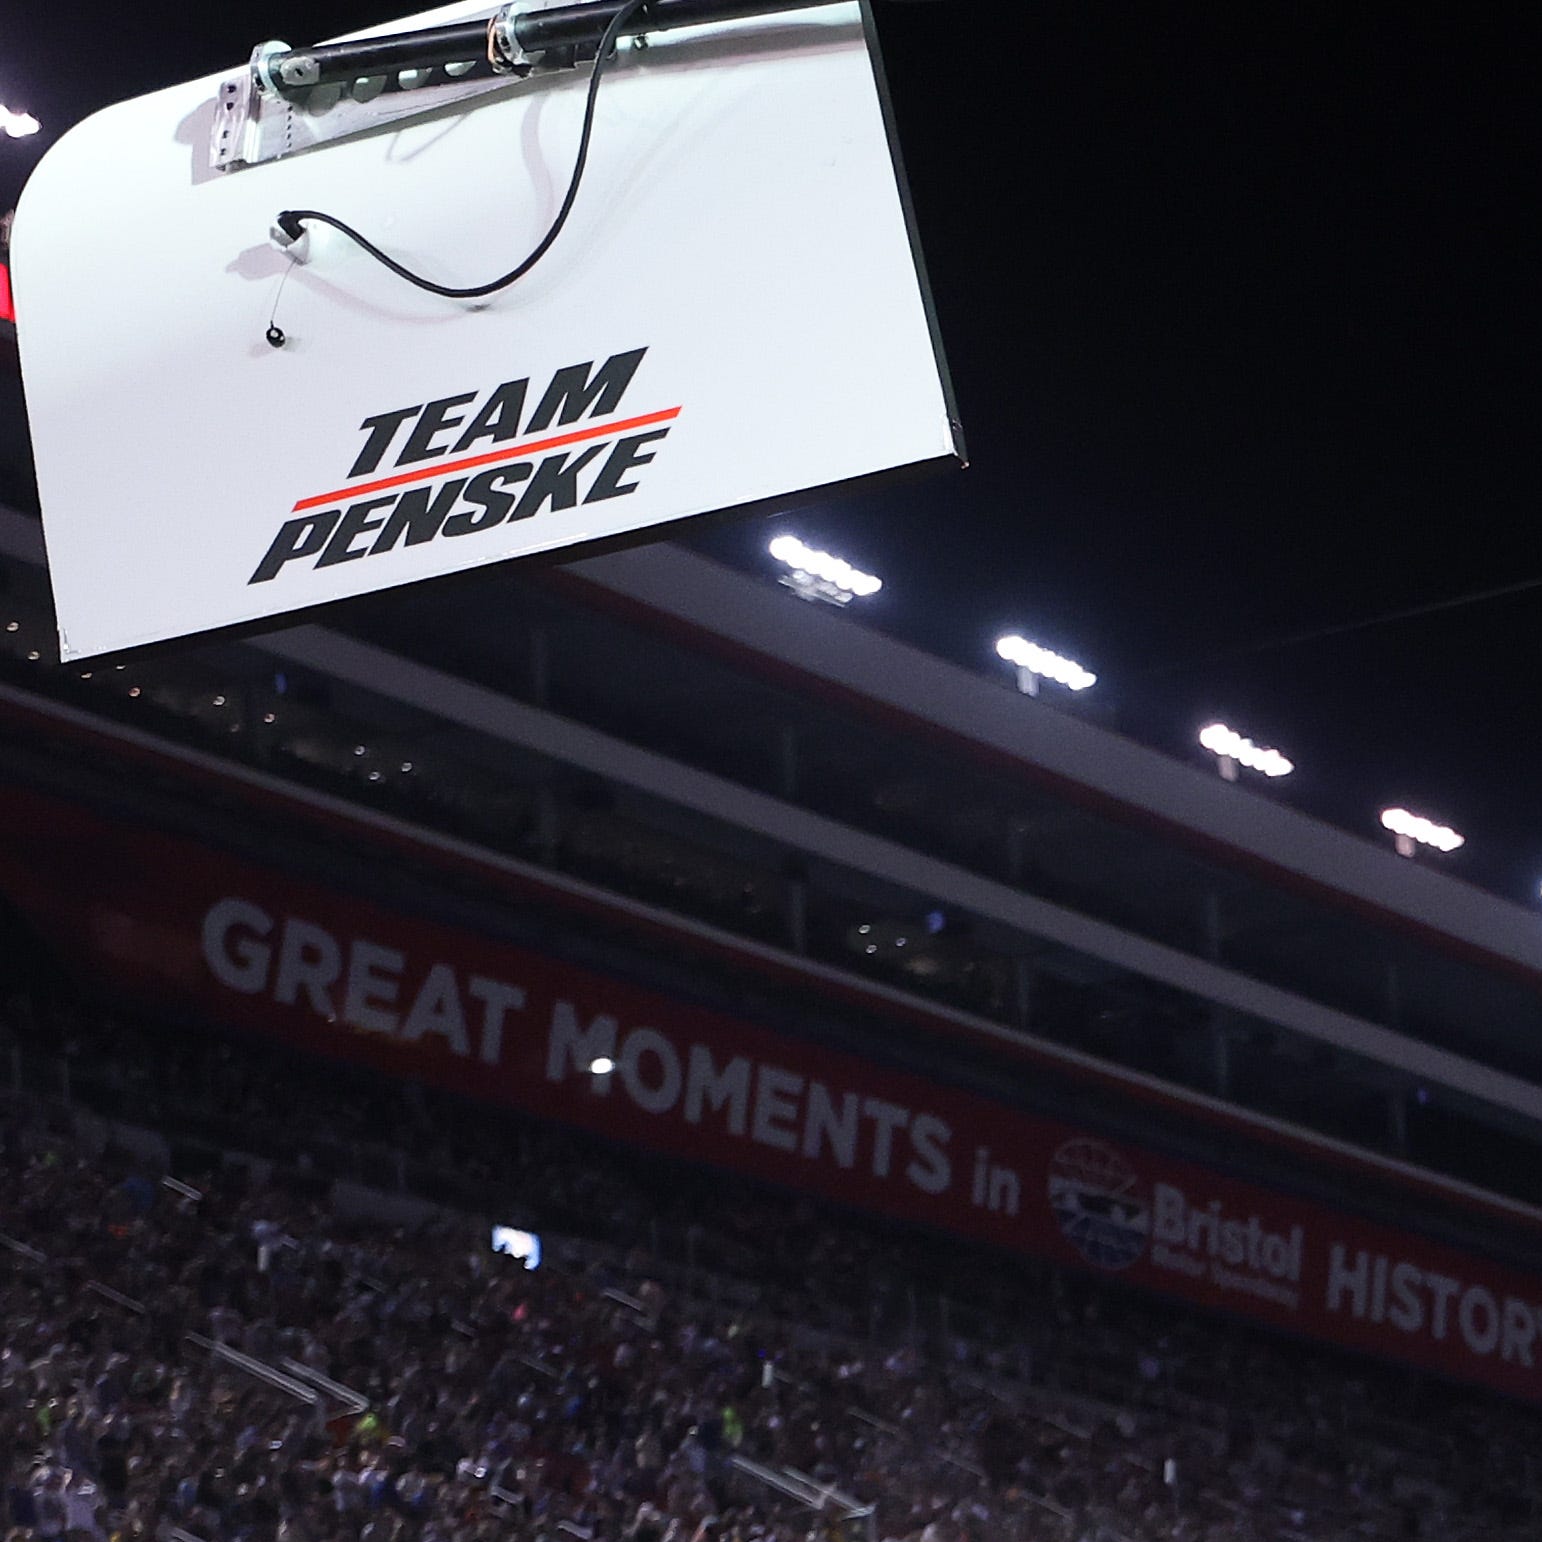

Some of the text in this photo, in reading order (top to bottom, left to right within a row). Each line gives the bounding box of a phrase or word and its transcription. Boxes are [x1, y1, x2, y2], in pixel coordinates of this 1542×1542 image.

[347, 346, 649, 478] TEAM
[248, 427, 670, 585] PENSKE
[202, 898, 525, 1064] GREAT
[547, 1002, 951, 1192] MOMENTS
[972, 1150, 1019, 1216] in
[1154, 1183, 1304, 1280] Bristol
